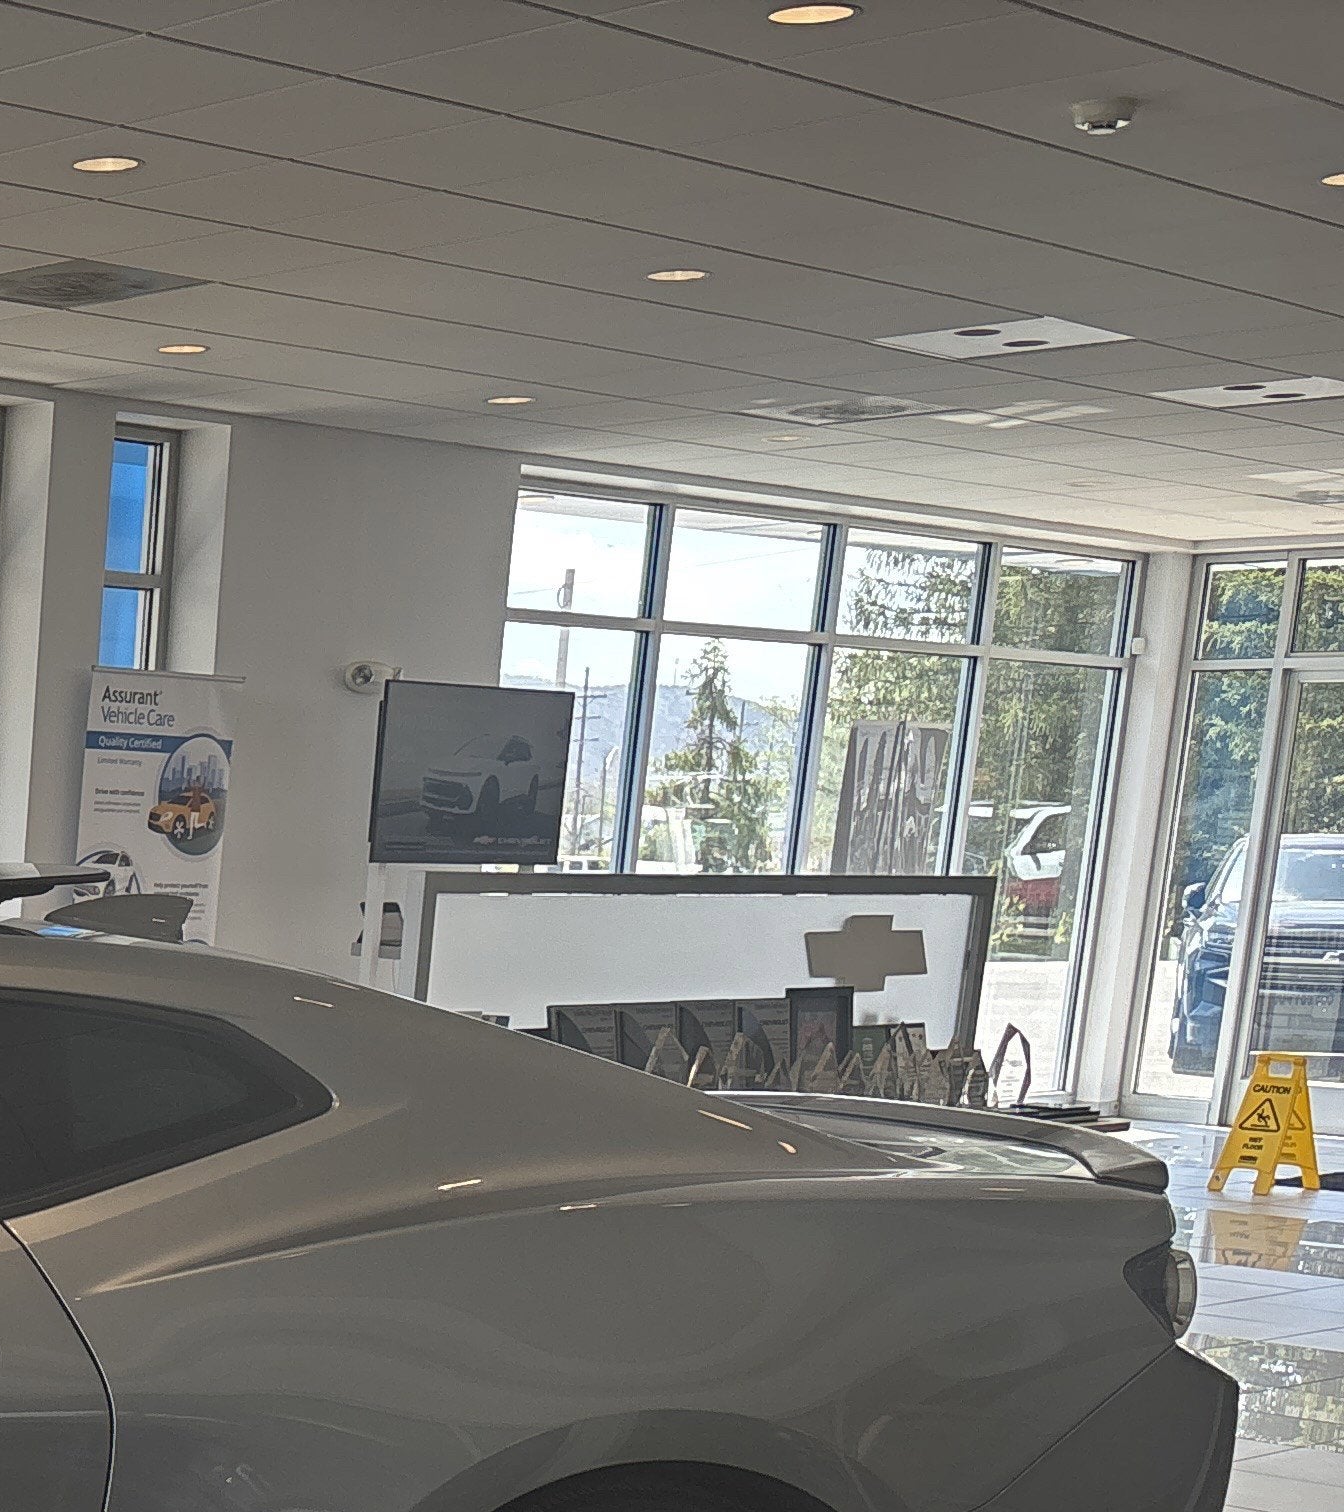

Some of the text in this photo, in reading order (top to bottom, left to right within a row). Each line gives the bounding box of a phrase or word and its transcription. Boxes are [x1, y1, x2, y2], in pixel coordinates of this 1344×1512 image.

[101, 685, 160, 706] Assurant
[101, 705, 175, 727] Vehicle Care
[98, 736, 128, 750] Quality
[1253, 1084, 1291, 1095] CAUTION
